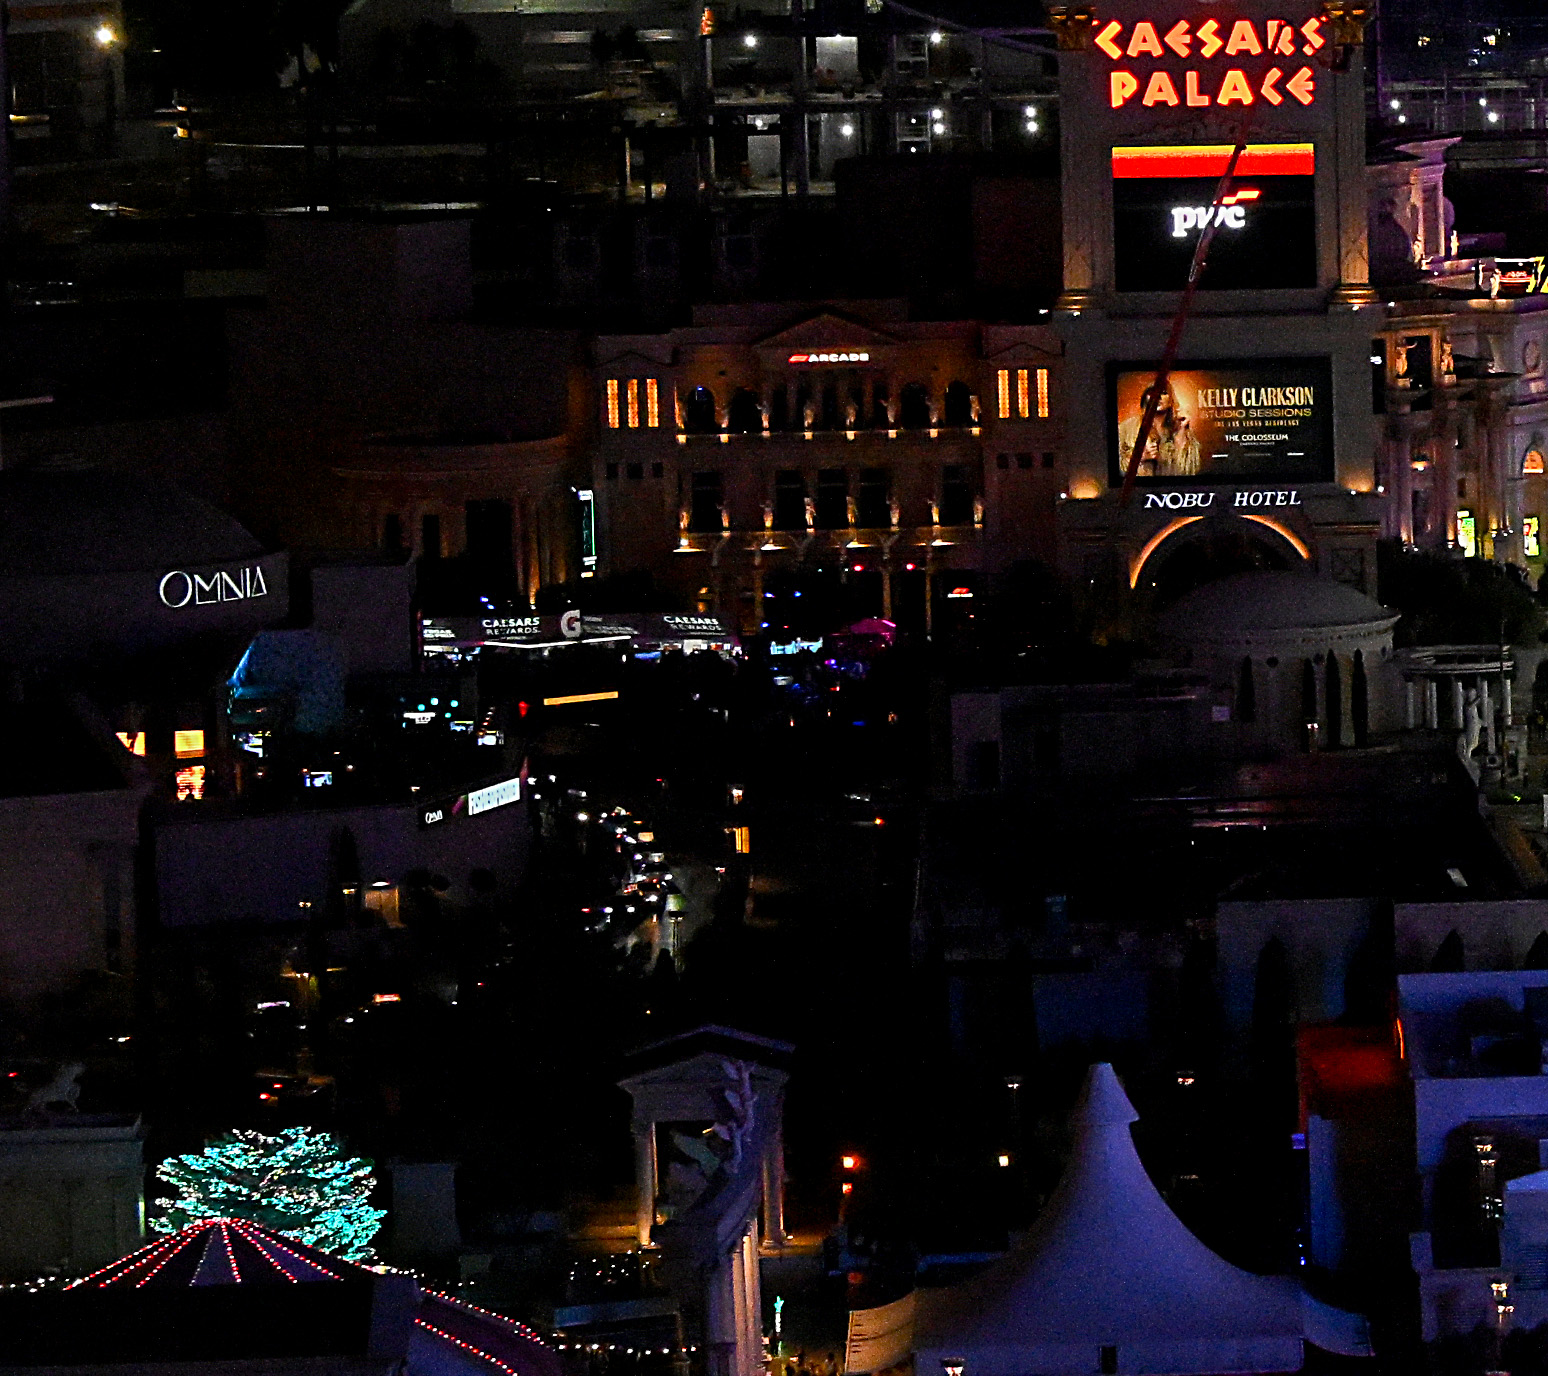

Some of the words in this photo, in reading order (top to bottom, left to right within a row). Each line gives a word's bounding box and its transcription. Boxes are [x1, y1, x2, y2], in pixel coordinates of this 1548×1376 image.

[1095, 17, 1328, 60] CAESARS
[1110, 66, 1316, 109] PALACE
[1172, 206, 1246, 238] pwc
[808, 353, 871, 363] ARCADE
[1198, 386, 1237, 408] KELLY
[1241, 386, 1315, 408] CLARKSON
[1203, 409, 1246, 419] STUDIO
[1249, 408, 1312, 418] SESSIONS
[1225, 434, 1239, 442] THE
[1240, 433, 1290, 442] COLOSSEUM
[1143, 491, 1215, 510] NOBU
[1233, 490, 1302, 508] HOTEL
[160, 566, 268, 608] OMNIA
[483, 617, 541, 628] CAESARS
[663, 615, 721, 626] CAESARS
